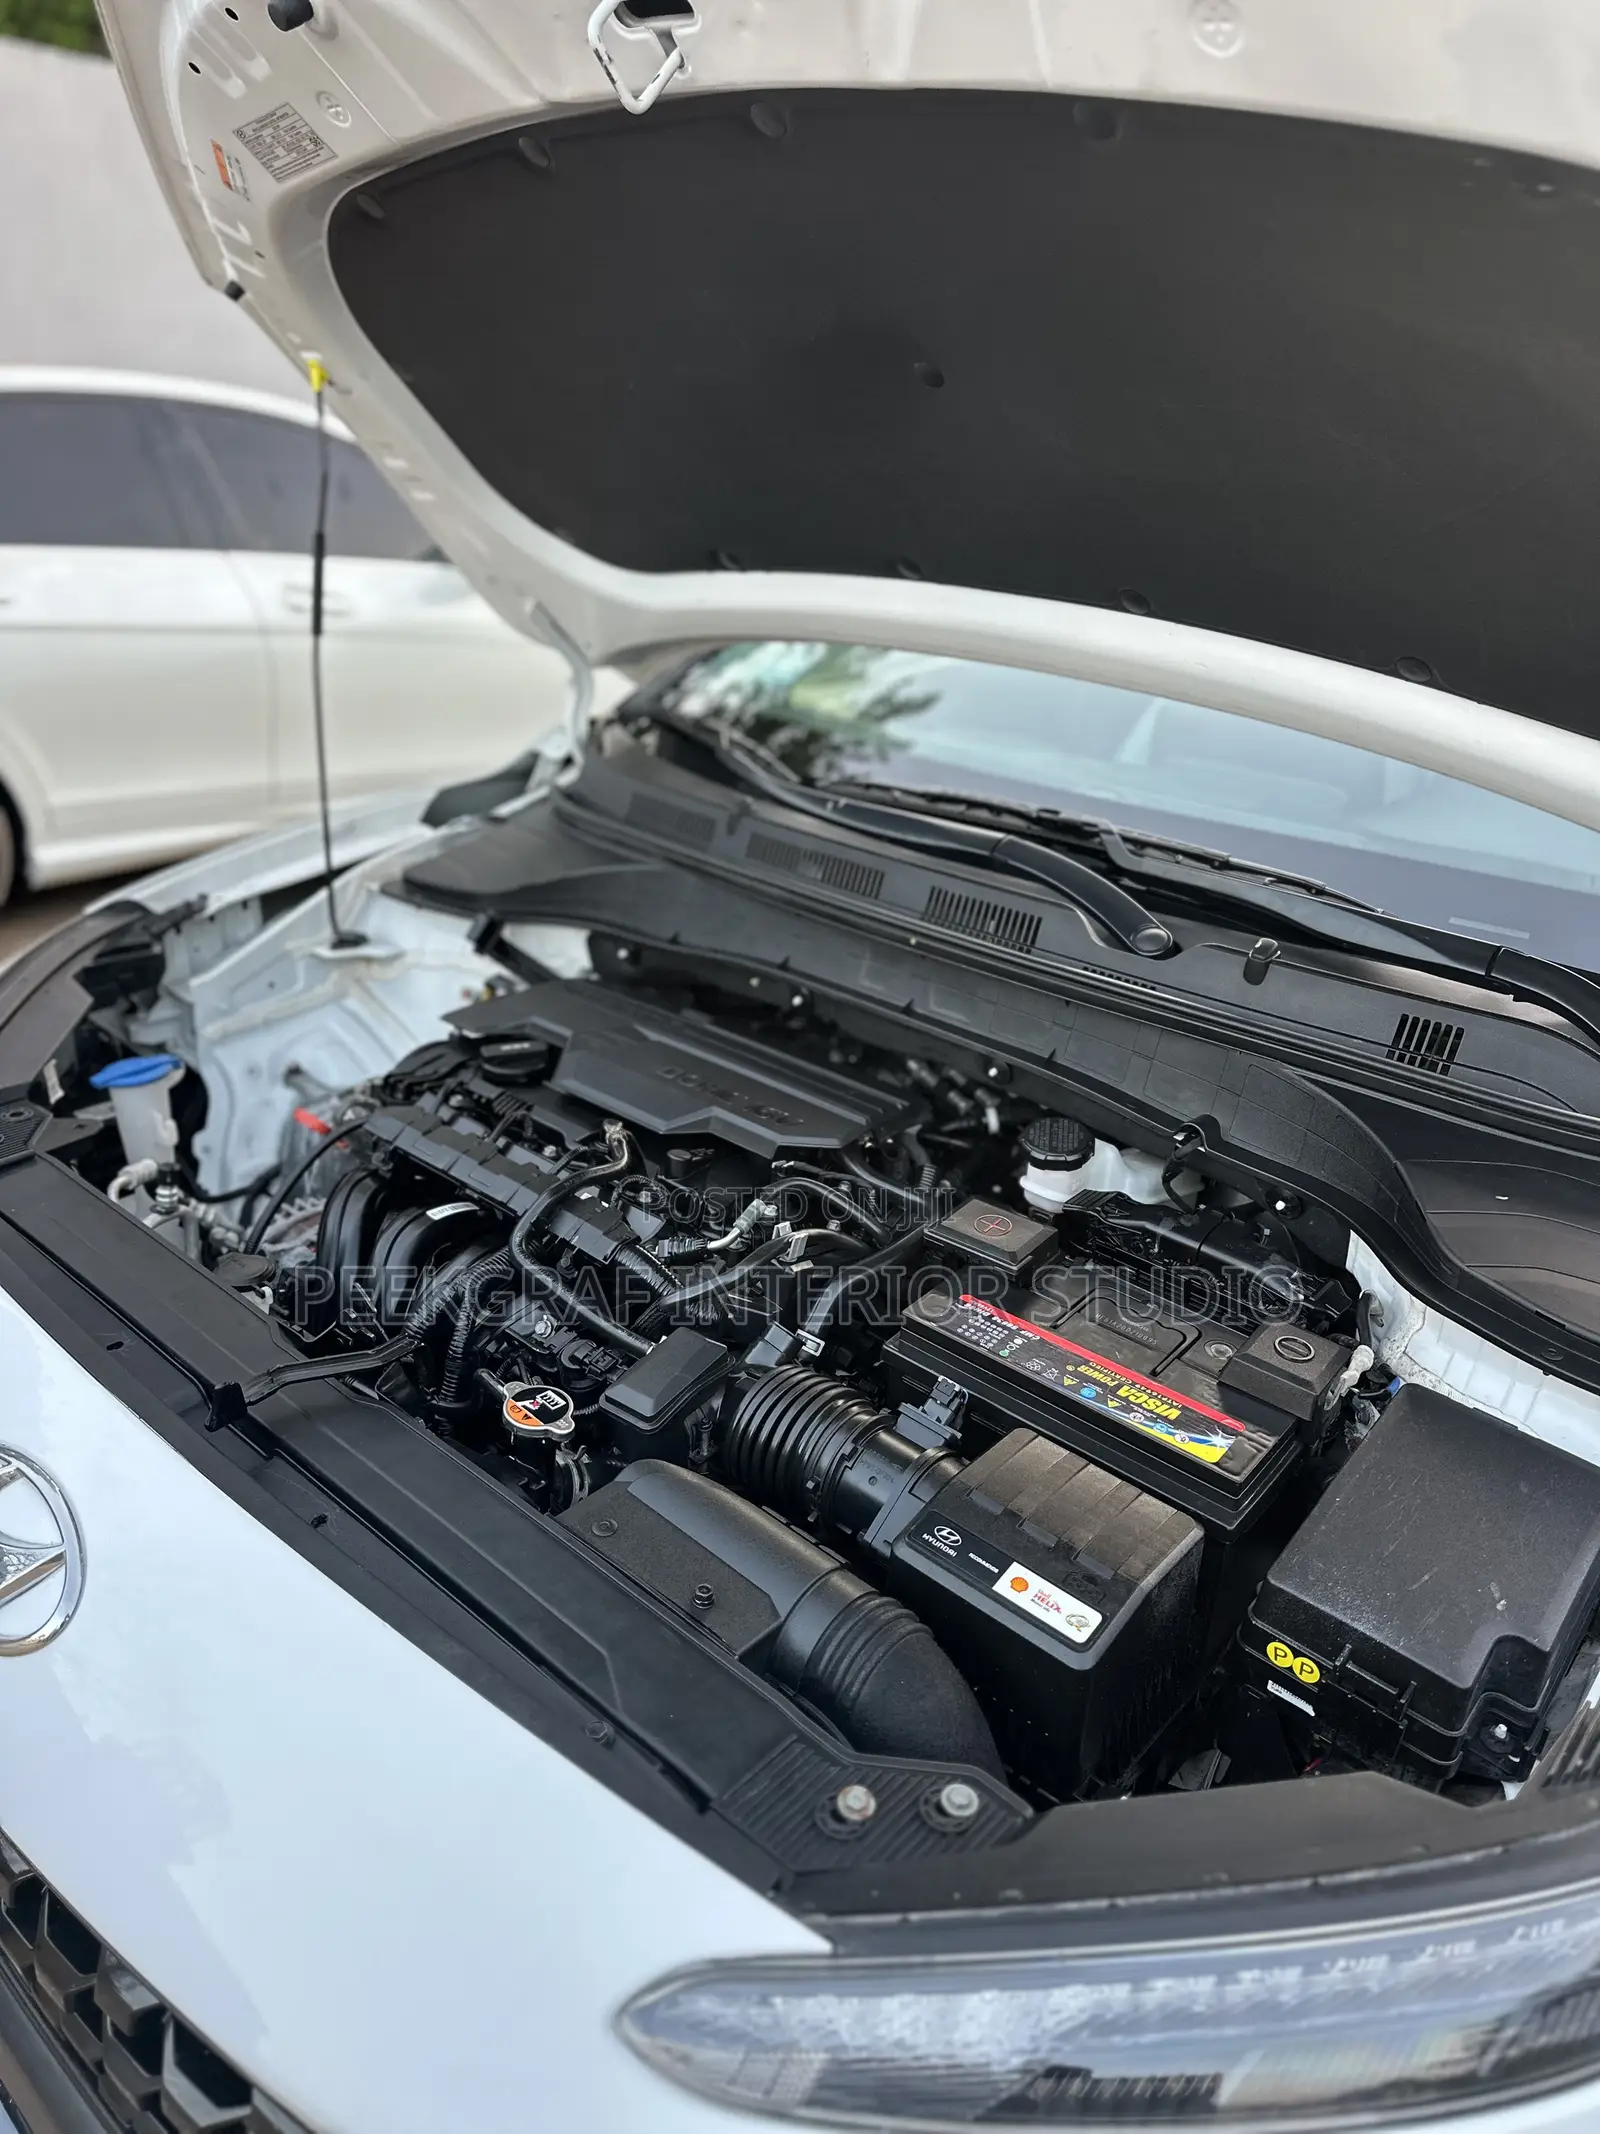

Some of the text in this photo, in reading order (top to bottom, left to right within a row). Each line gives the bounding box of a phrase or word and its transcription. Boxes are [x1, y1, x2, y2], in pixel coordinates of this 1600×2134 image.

[1076, 1364, 1118, 1387] POWER
[1088, 1361, 1132, 1384] CERTIFIED
[1115, 1384, 1181, 1420] VISCA
[922, 1533, 957, 1557] HYUNDAI
[1033, 1592, 1061, 1612] HELIX
[1274, 1646, 1314, 1676] P P
